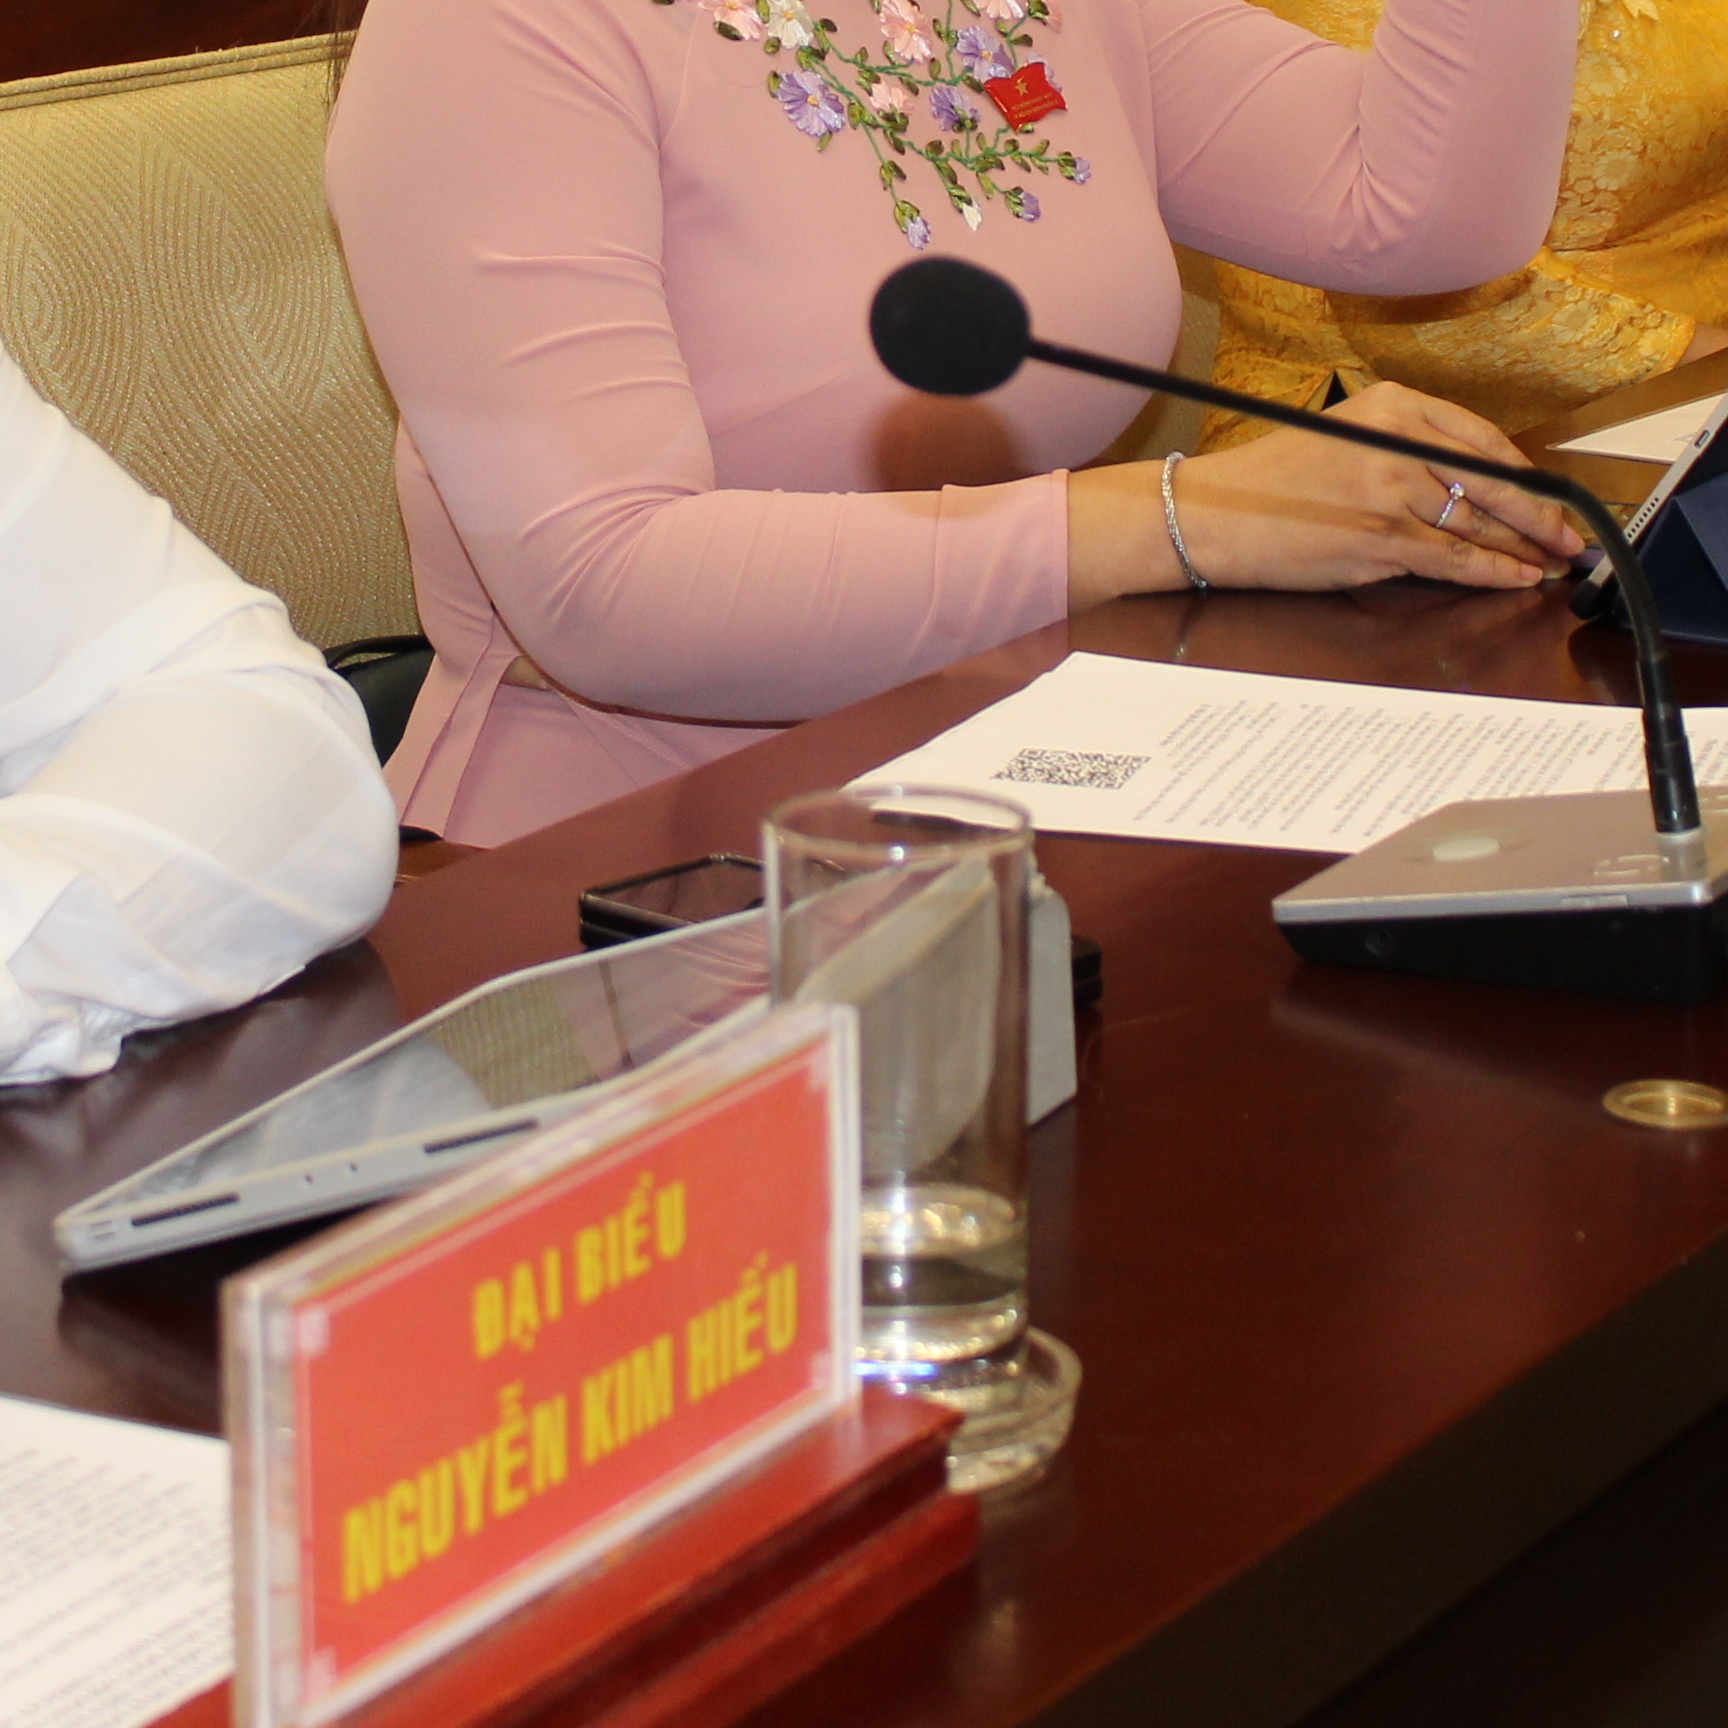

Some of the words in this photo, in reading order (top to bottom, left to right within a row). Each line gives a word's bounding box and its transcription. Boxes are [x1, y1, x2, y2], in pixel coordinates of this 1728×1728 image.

[471, 1246, 563, 1361] ĐẠI
[574, 1170, 688, 1306] BIỂU
[340, 1380, 569, 1605] NGUYỄN
[580, 1333, 675, 1466] KIM
[685, 1248, 800, 1404] HIẾU
